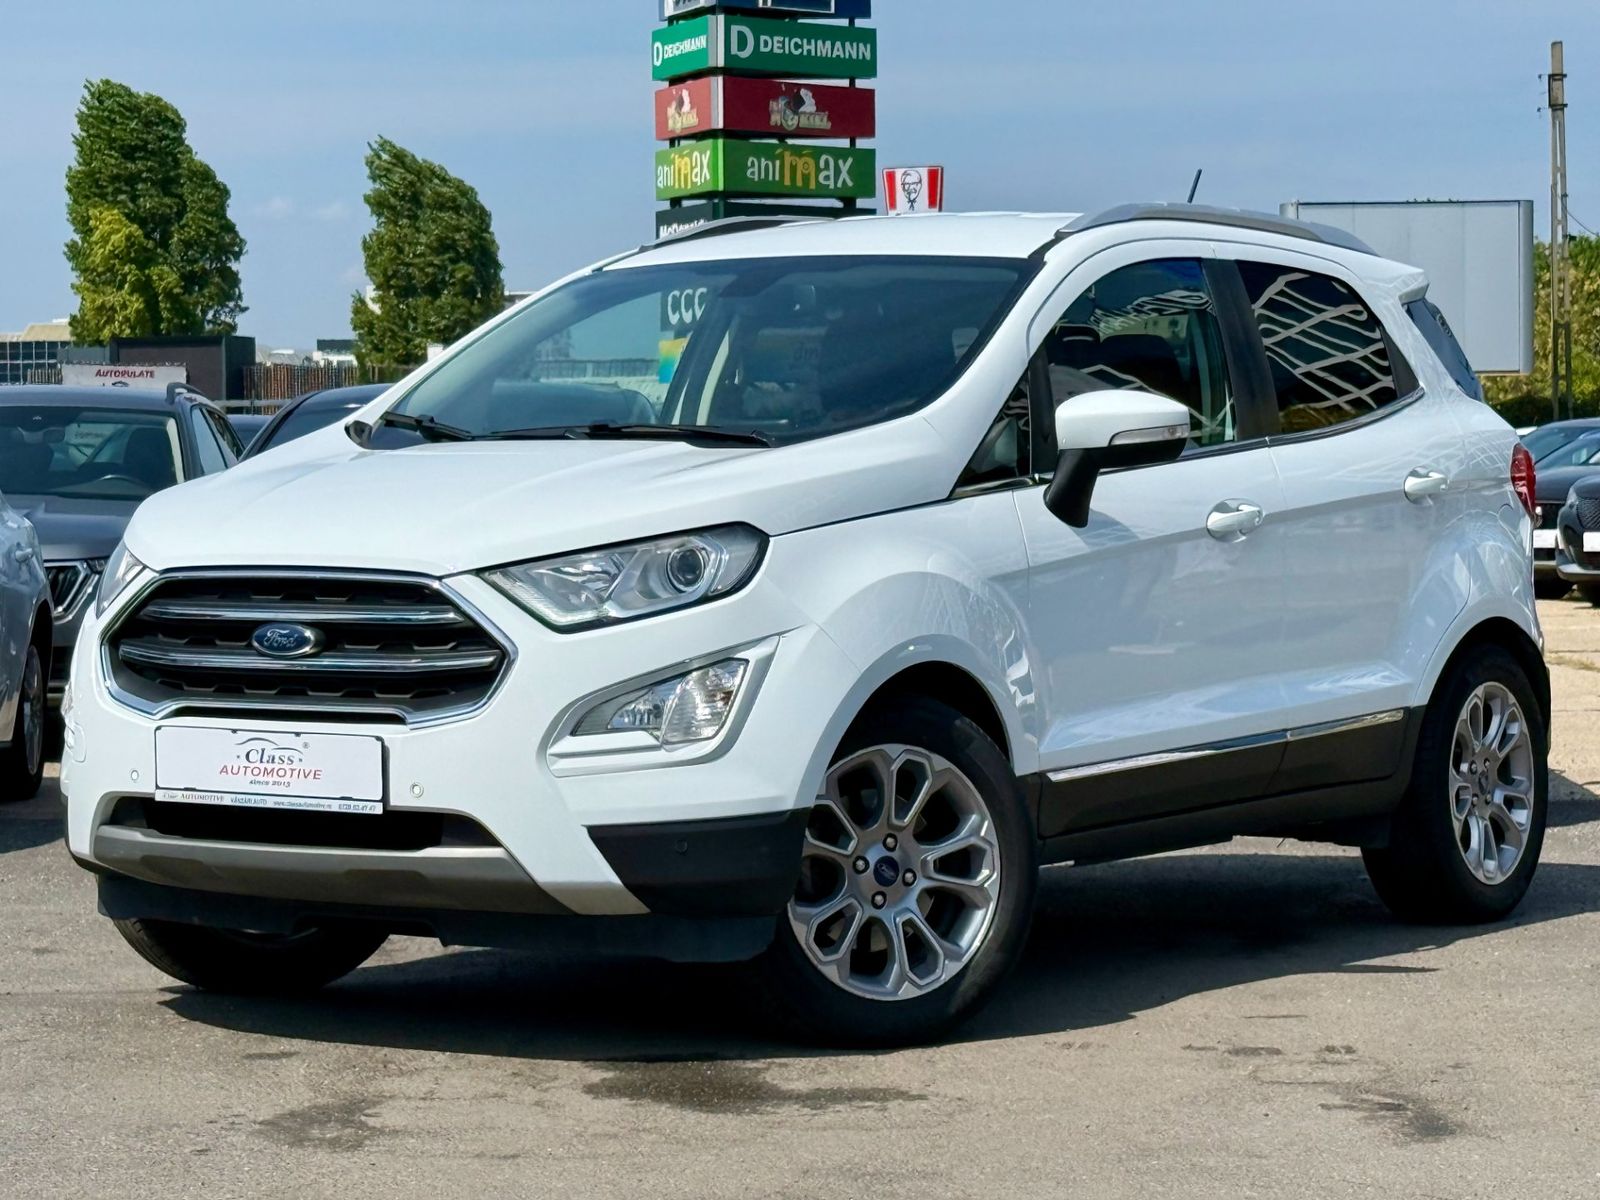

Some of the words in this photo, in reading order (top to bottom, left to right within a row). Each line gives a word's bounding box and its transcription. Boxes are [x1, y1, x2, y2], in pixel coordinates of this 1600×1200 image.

[653, 42, 663, 67] D
[663, 34, 708, 60] DEICHMANN
[730, 25, 755, 59] D
[759, 35, 871, 61] DEICHMANN
[657, 148, 712, 190] animax
[747, 148, 854, 190] animax
[667, 287, 708, 325] CCC
[263, 628, 298, 647] Ford
[245, 748, 295, 766] Class
[219, 764, 323, 780] AUTOMOTIVE
[249, 779, 270, 787] since
[180, 793, 224, 803] AUTOMOTIVE
